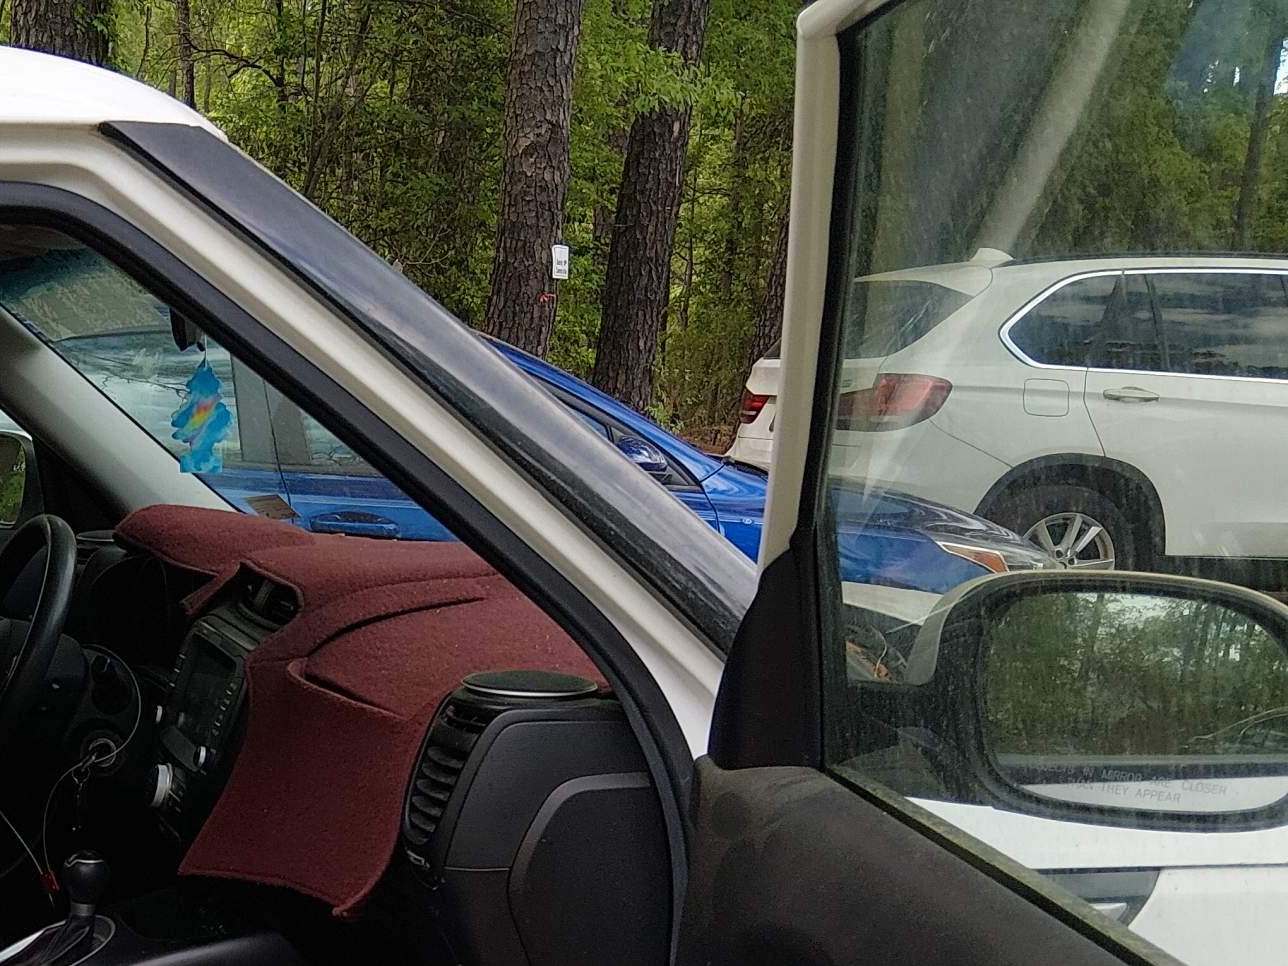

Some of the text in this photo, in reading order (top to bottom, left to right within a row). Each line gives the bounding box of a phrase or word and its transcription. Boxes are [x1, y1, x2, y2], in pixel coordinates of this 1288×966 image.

[1101, 769, 1143, 783] MIRROR
[1181, 780, 1229, 796] CLOSER
[1101, 782, 1129, 796] THEY
[1135, 787, 1182, 803] APPEAR
